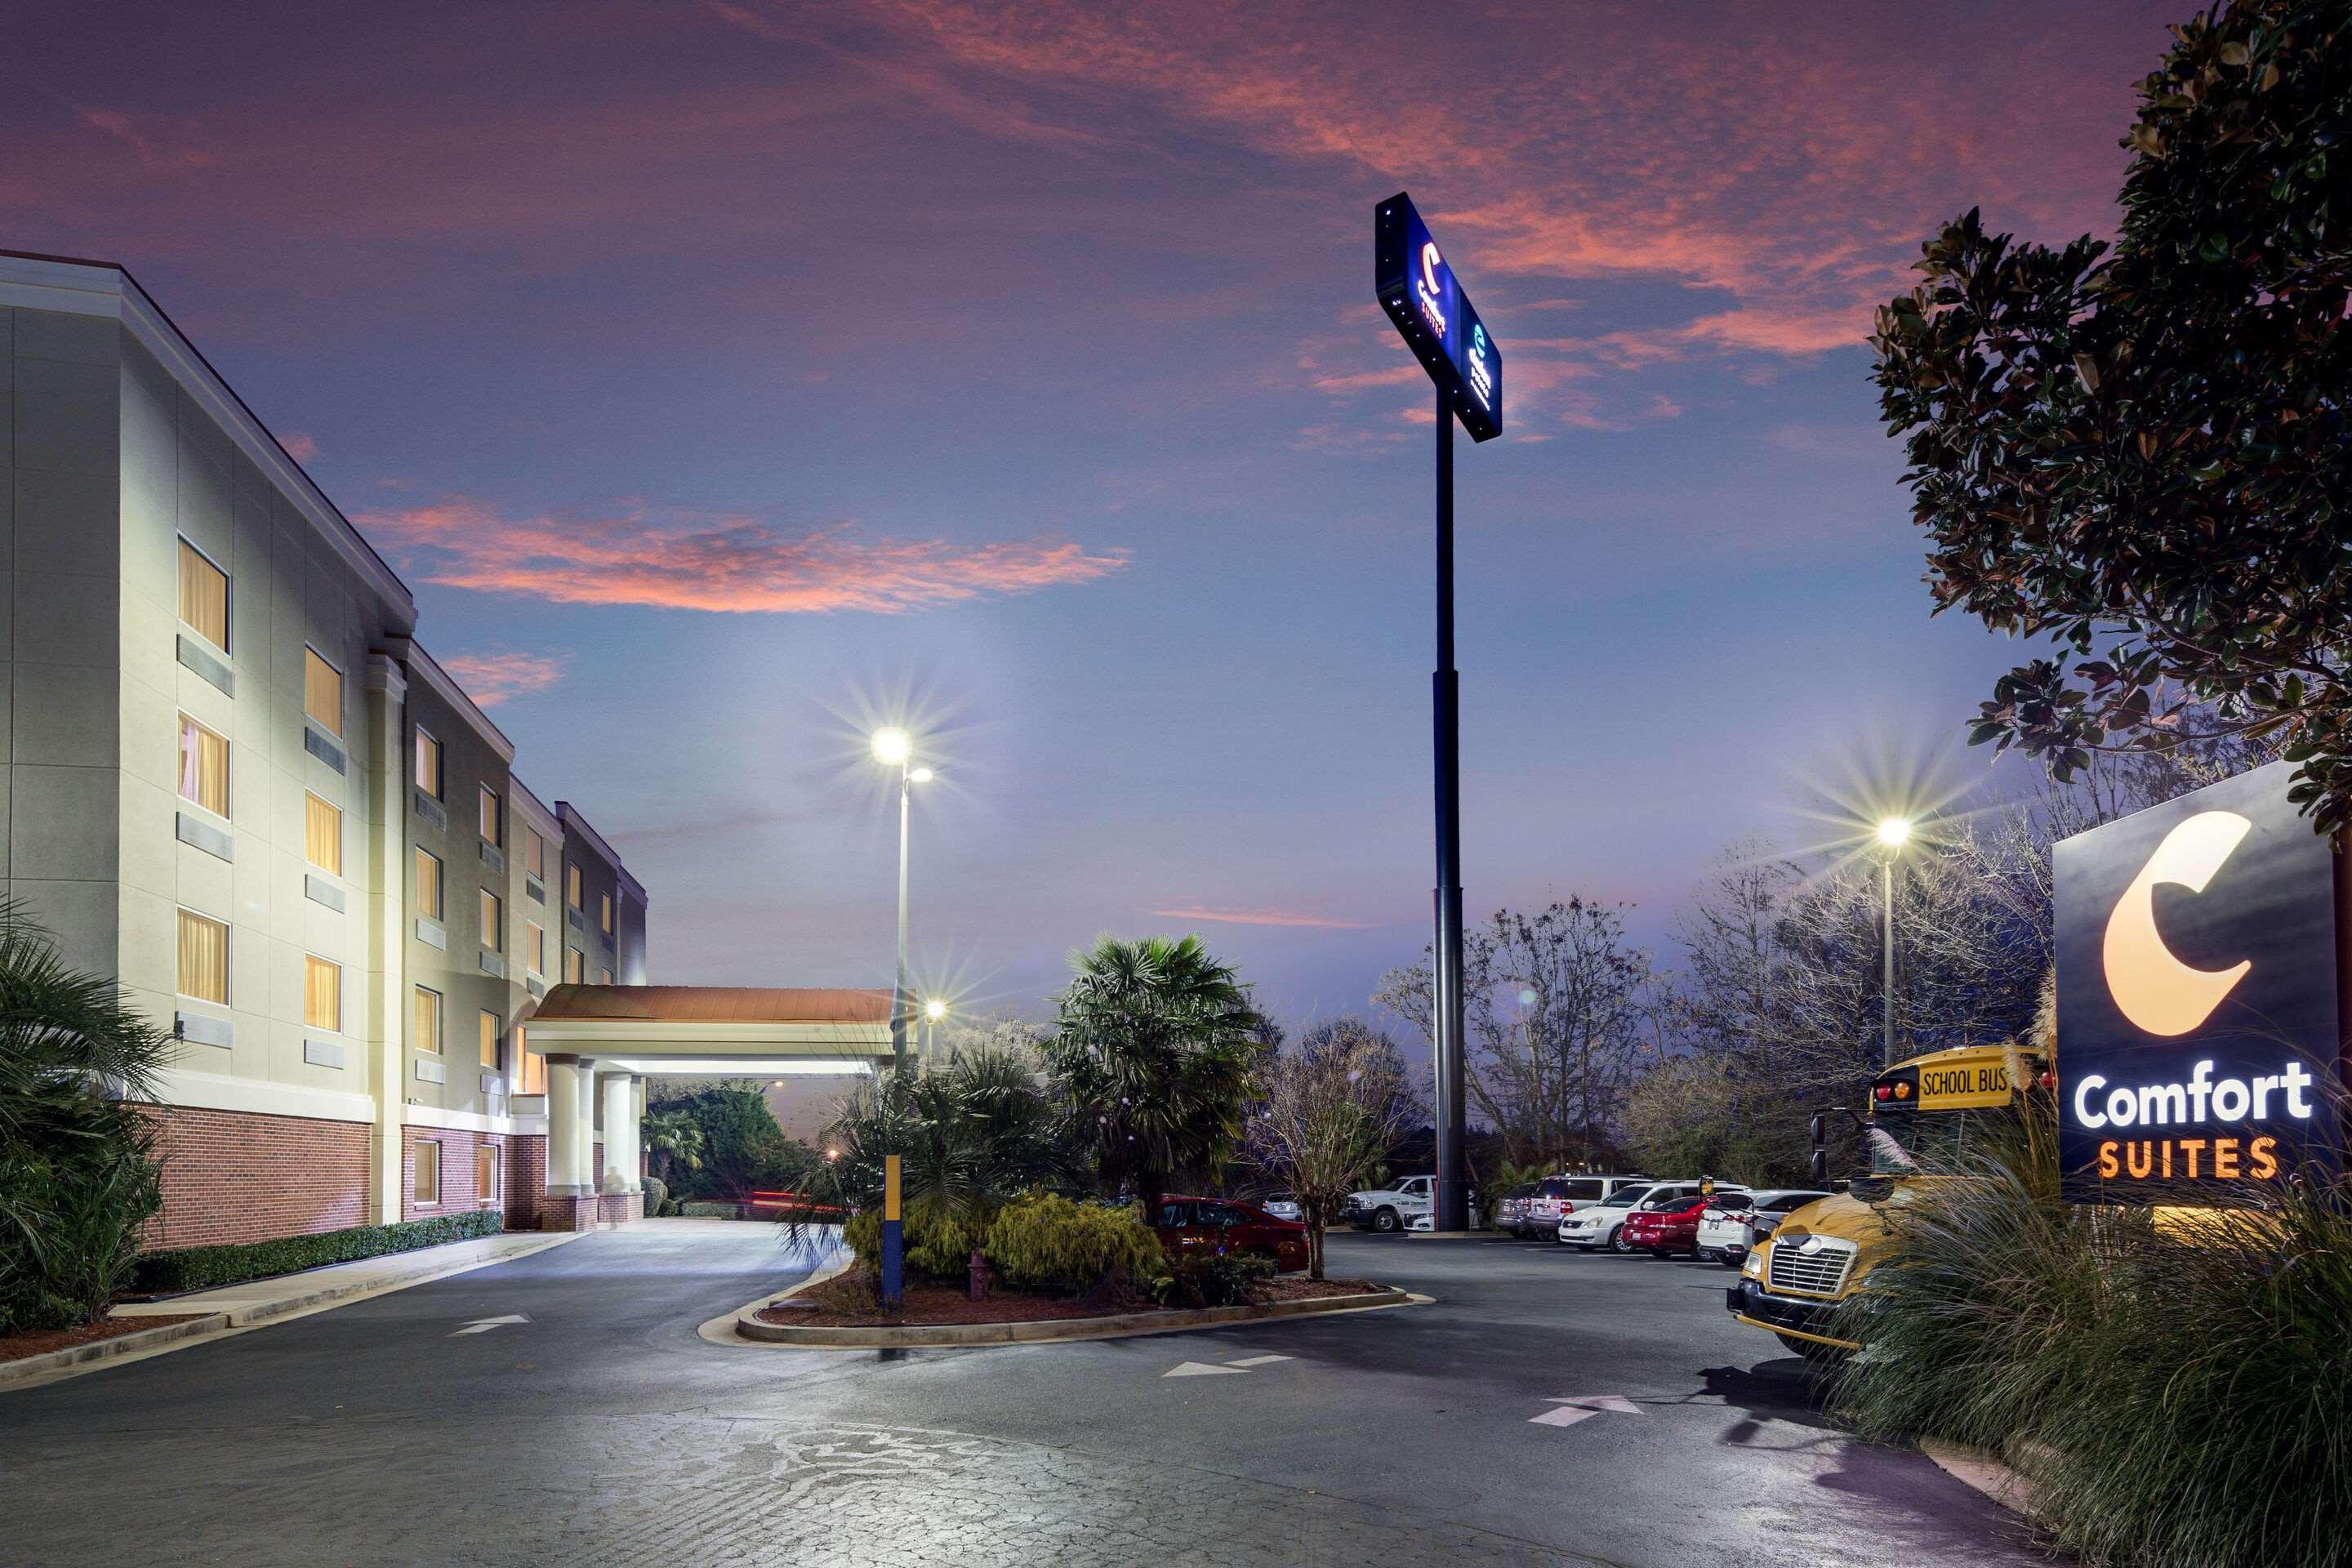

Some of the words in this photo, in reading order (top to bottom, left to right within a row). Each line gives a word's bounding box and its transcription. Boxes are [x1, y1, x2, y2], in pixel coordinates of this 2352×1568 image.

[1923, 1070, 1975, 1096] SCHOOL
[1979, 1067, 2007, 1092] BUS
[2074, 1060, 2313, 1129] Comfort
[2099, 1136, 2278, 1179] SUITES
